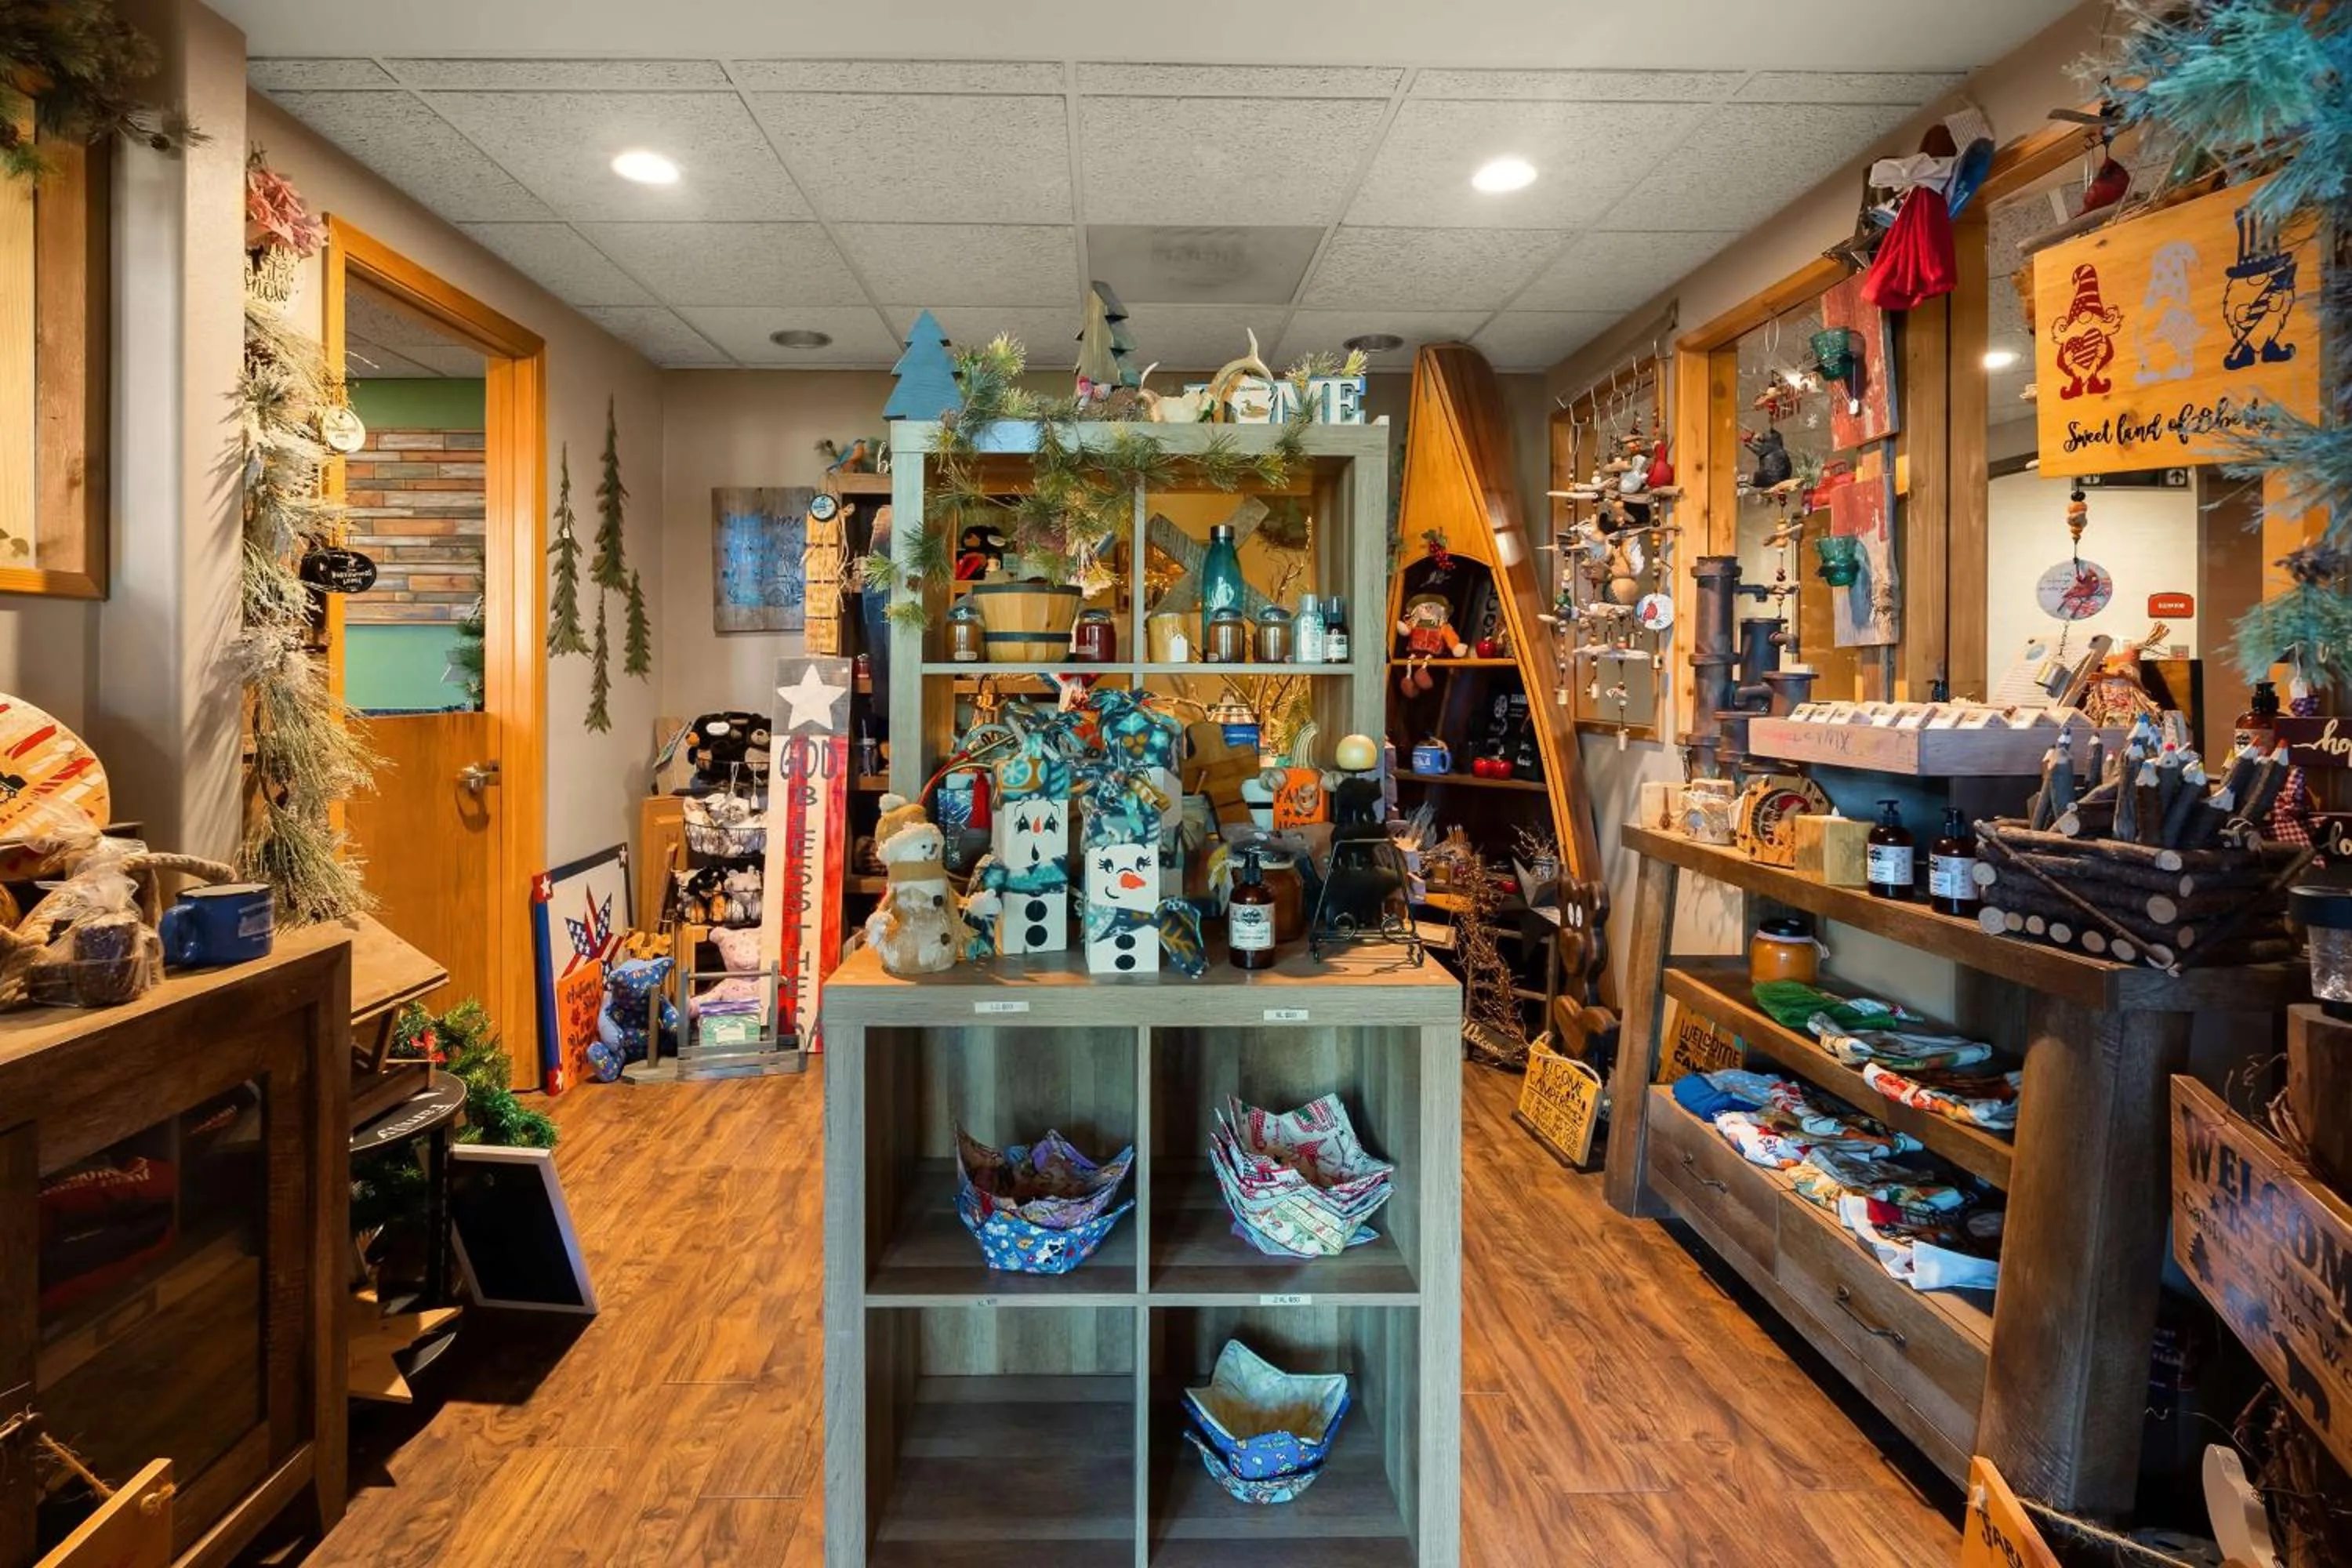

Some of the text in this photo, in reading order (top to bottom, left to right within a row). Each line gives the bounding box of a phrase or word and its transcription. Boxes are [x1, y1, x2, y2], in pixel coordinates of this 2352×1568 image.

[2063, 421, 2113, 452] Sweet
[2116, 413, 2162, 445] land
[780, 738, 838, 781] GOD
[2264, 1276, 2307, 1336] The
[2269, 1244, 2325, 1323] Our
